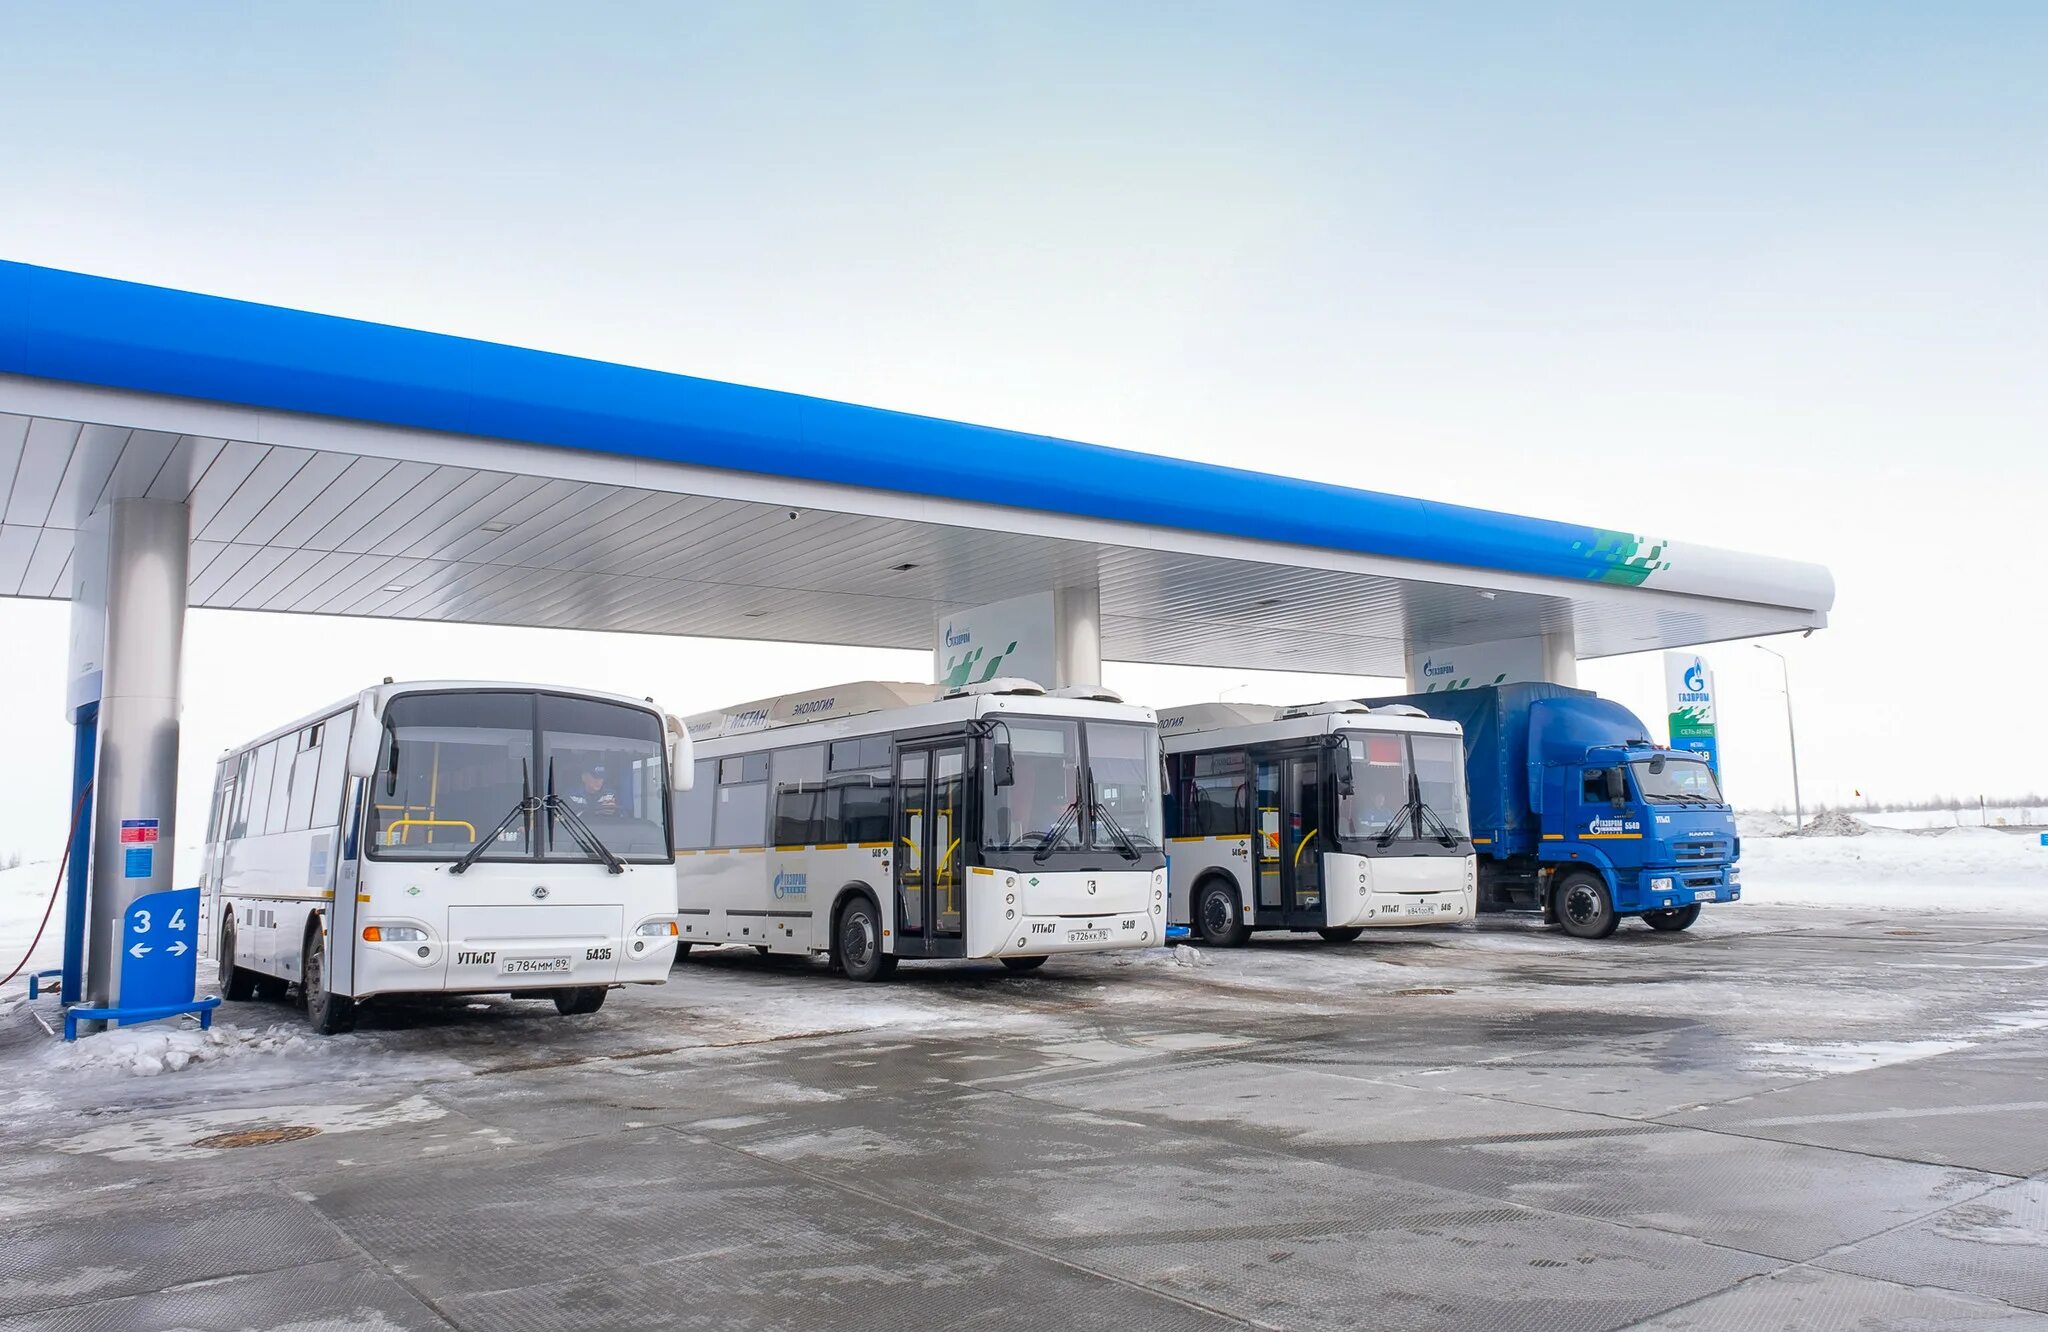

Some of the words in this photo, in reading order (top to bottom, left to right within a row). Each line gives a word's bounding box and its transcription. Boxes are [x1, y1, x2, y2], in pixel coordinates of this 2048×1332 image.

[1678, 693, 1709, 701] ГАЗПРОМ
[730, 709, 769, 729] МЕТАН
[792, 697, 835, 716] ЭКОЛОГИЯ
[1157, 716, 1184, 729] ЛОГИЯ
[133, 910, 151, 934] 3
[168, 908, 186, 931] 4
[1031, 923, 1056, 934] УТТиСТ
[457, 952, 496, 964] УТТиСТ
[586, 948, 611, 960] 5435
[555, 959, 567, 968] 89
